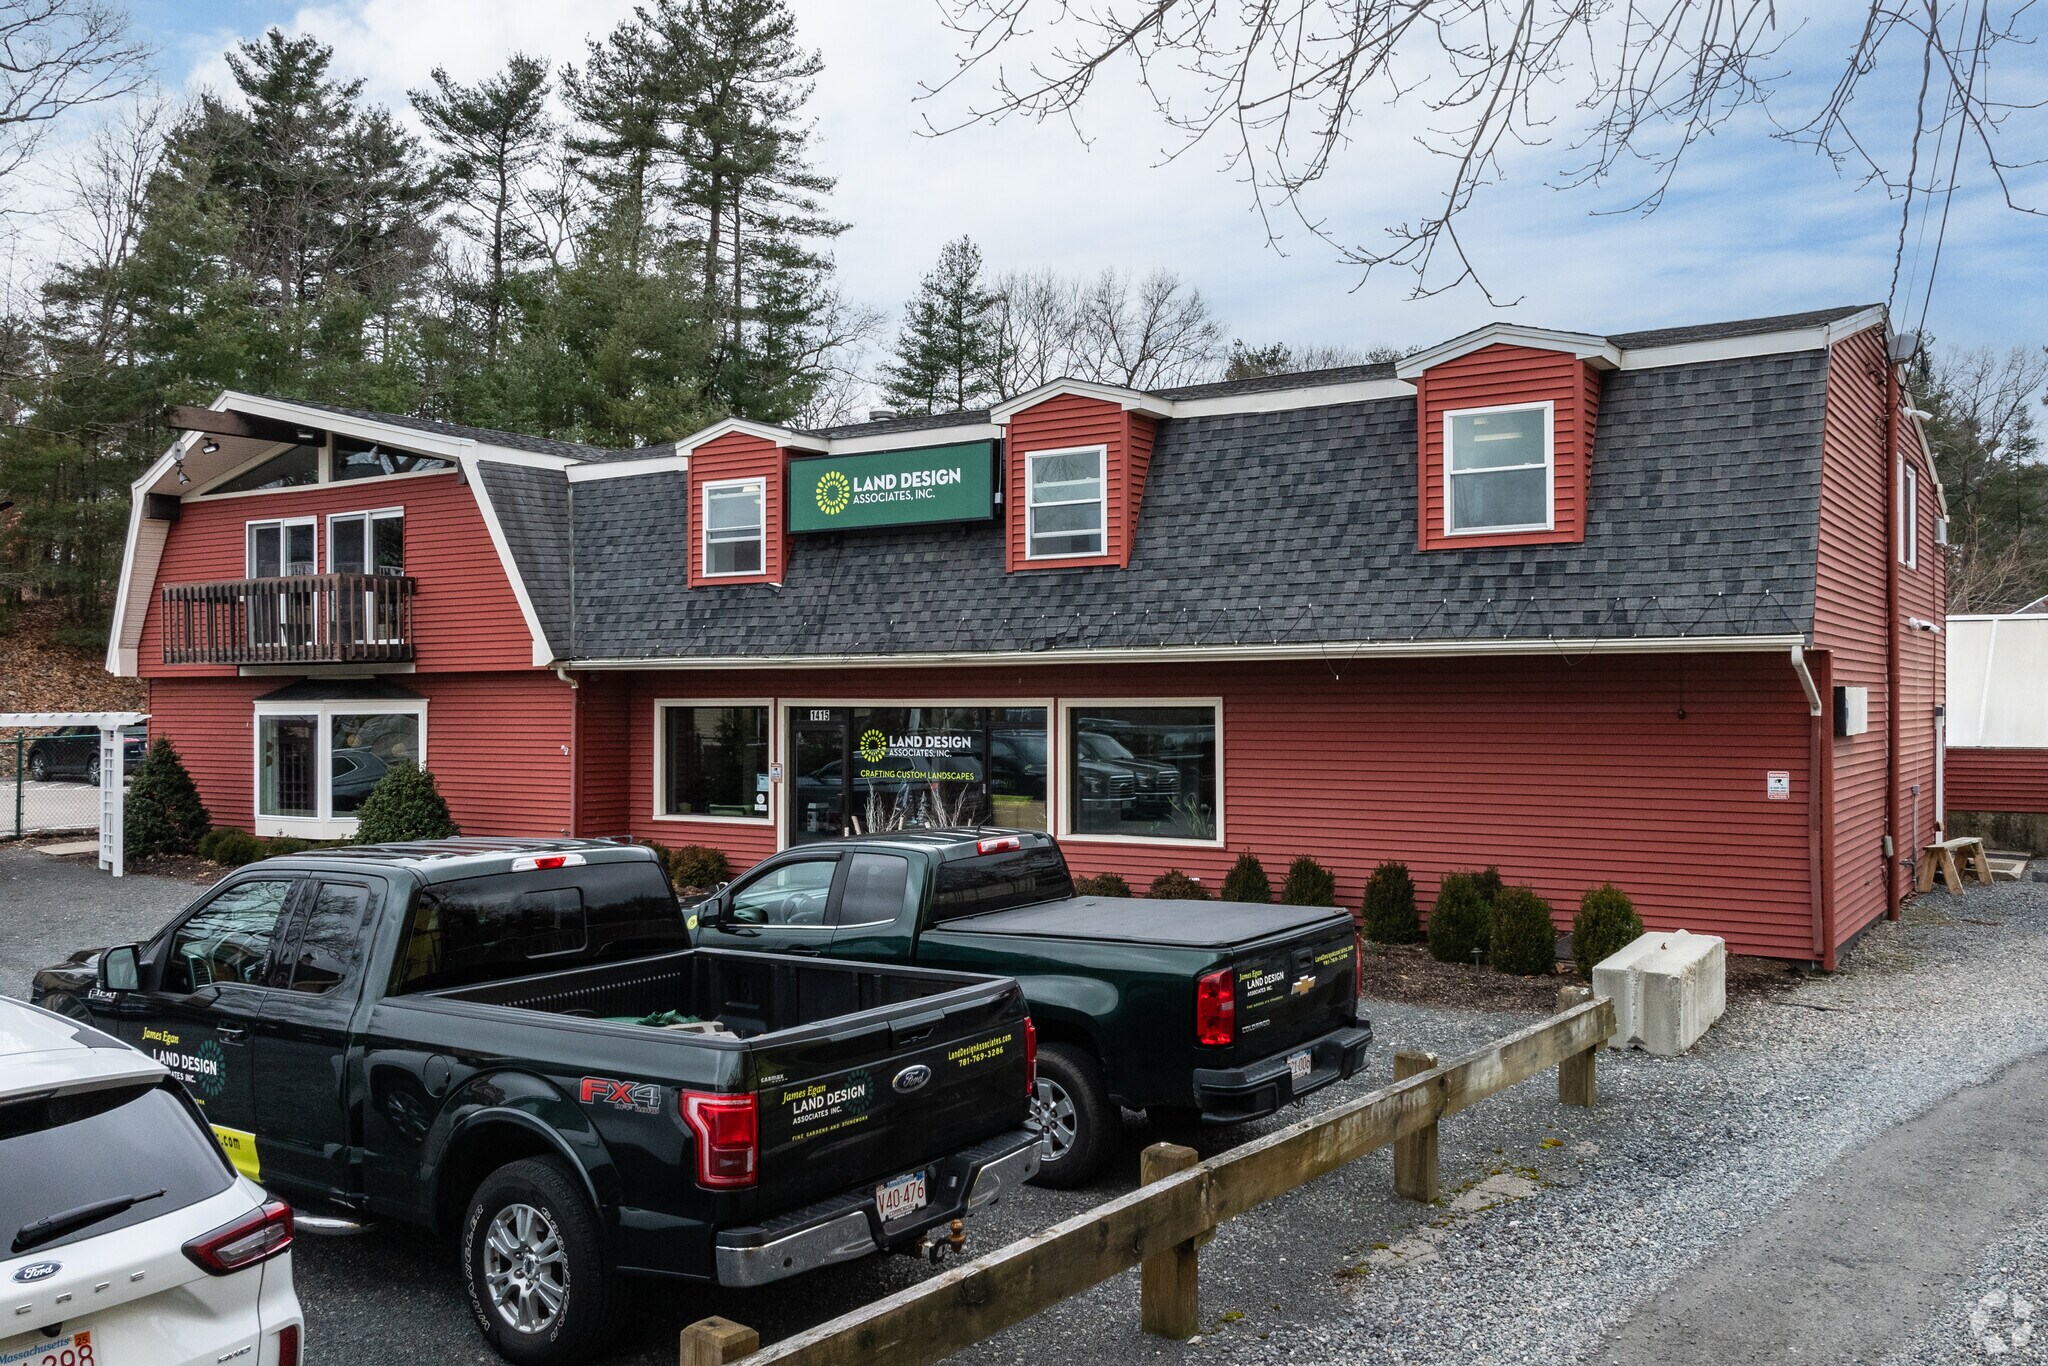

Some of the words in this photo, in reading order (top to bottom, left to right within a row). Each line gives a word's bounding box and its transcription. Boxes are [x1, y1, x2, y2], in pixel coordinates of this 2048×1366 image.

[853, 474, 897, 493] LAND
[900, 467, 961, 489] DESIGN
[852, 490, 914, 505] ASSOCIATES,
[915, 488, 936, 500] INC.
[810, 709, 830, 721] 1415
[889, 735, 923, 748] LAND
[925, 736, 972, 748] DESIGN
[888, 749, 935, 758] ASSOCIATES,
[936, 750, 952, 758] INC.
[860, 769, 895, 779] CRAFTING
[896, 770, 927, 780] CUSTOM
[927, 772, 975, 781] LANDSCAPES
[1247, 978, 1263, 989] LAND
[1264, 971, 1284, 984] DESIGN
[142, 1026, 162, 1041] James
[162, 1030, 180, 1046] Egan
[948, 1033, 1013, 1061] LandDesignAssociates.com
[958, 1046, 1004, 1067] 781-769-3286
[153, 1048, 180, 1068] LAND
[181, 1054, 218, 1076] DESIGN
[903, 1071, 925, 1087] Ford
[580, 1075, 661, 1109] FX4
[781, 1089, 806, 1105] James
[807, 1084, 827, 1098] Egan
[793, 1095, 825, 1115] LAND
[826, 1083, 866, 1106] DESIGN
[791, 1109, 829, 1126] ASSOCIATES
[830, 1105, 843, 1115] INC.
[805, 1126, 829, 1138] GARDENS
[23, 1264, 54, 1279] Ford
[464, 1204, 491, 1332] WRANGLER
[0, 1336, 70, 1364] Massachusetts
[77, 1335, 88, 1346] 25
